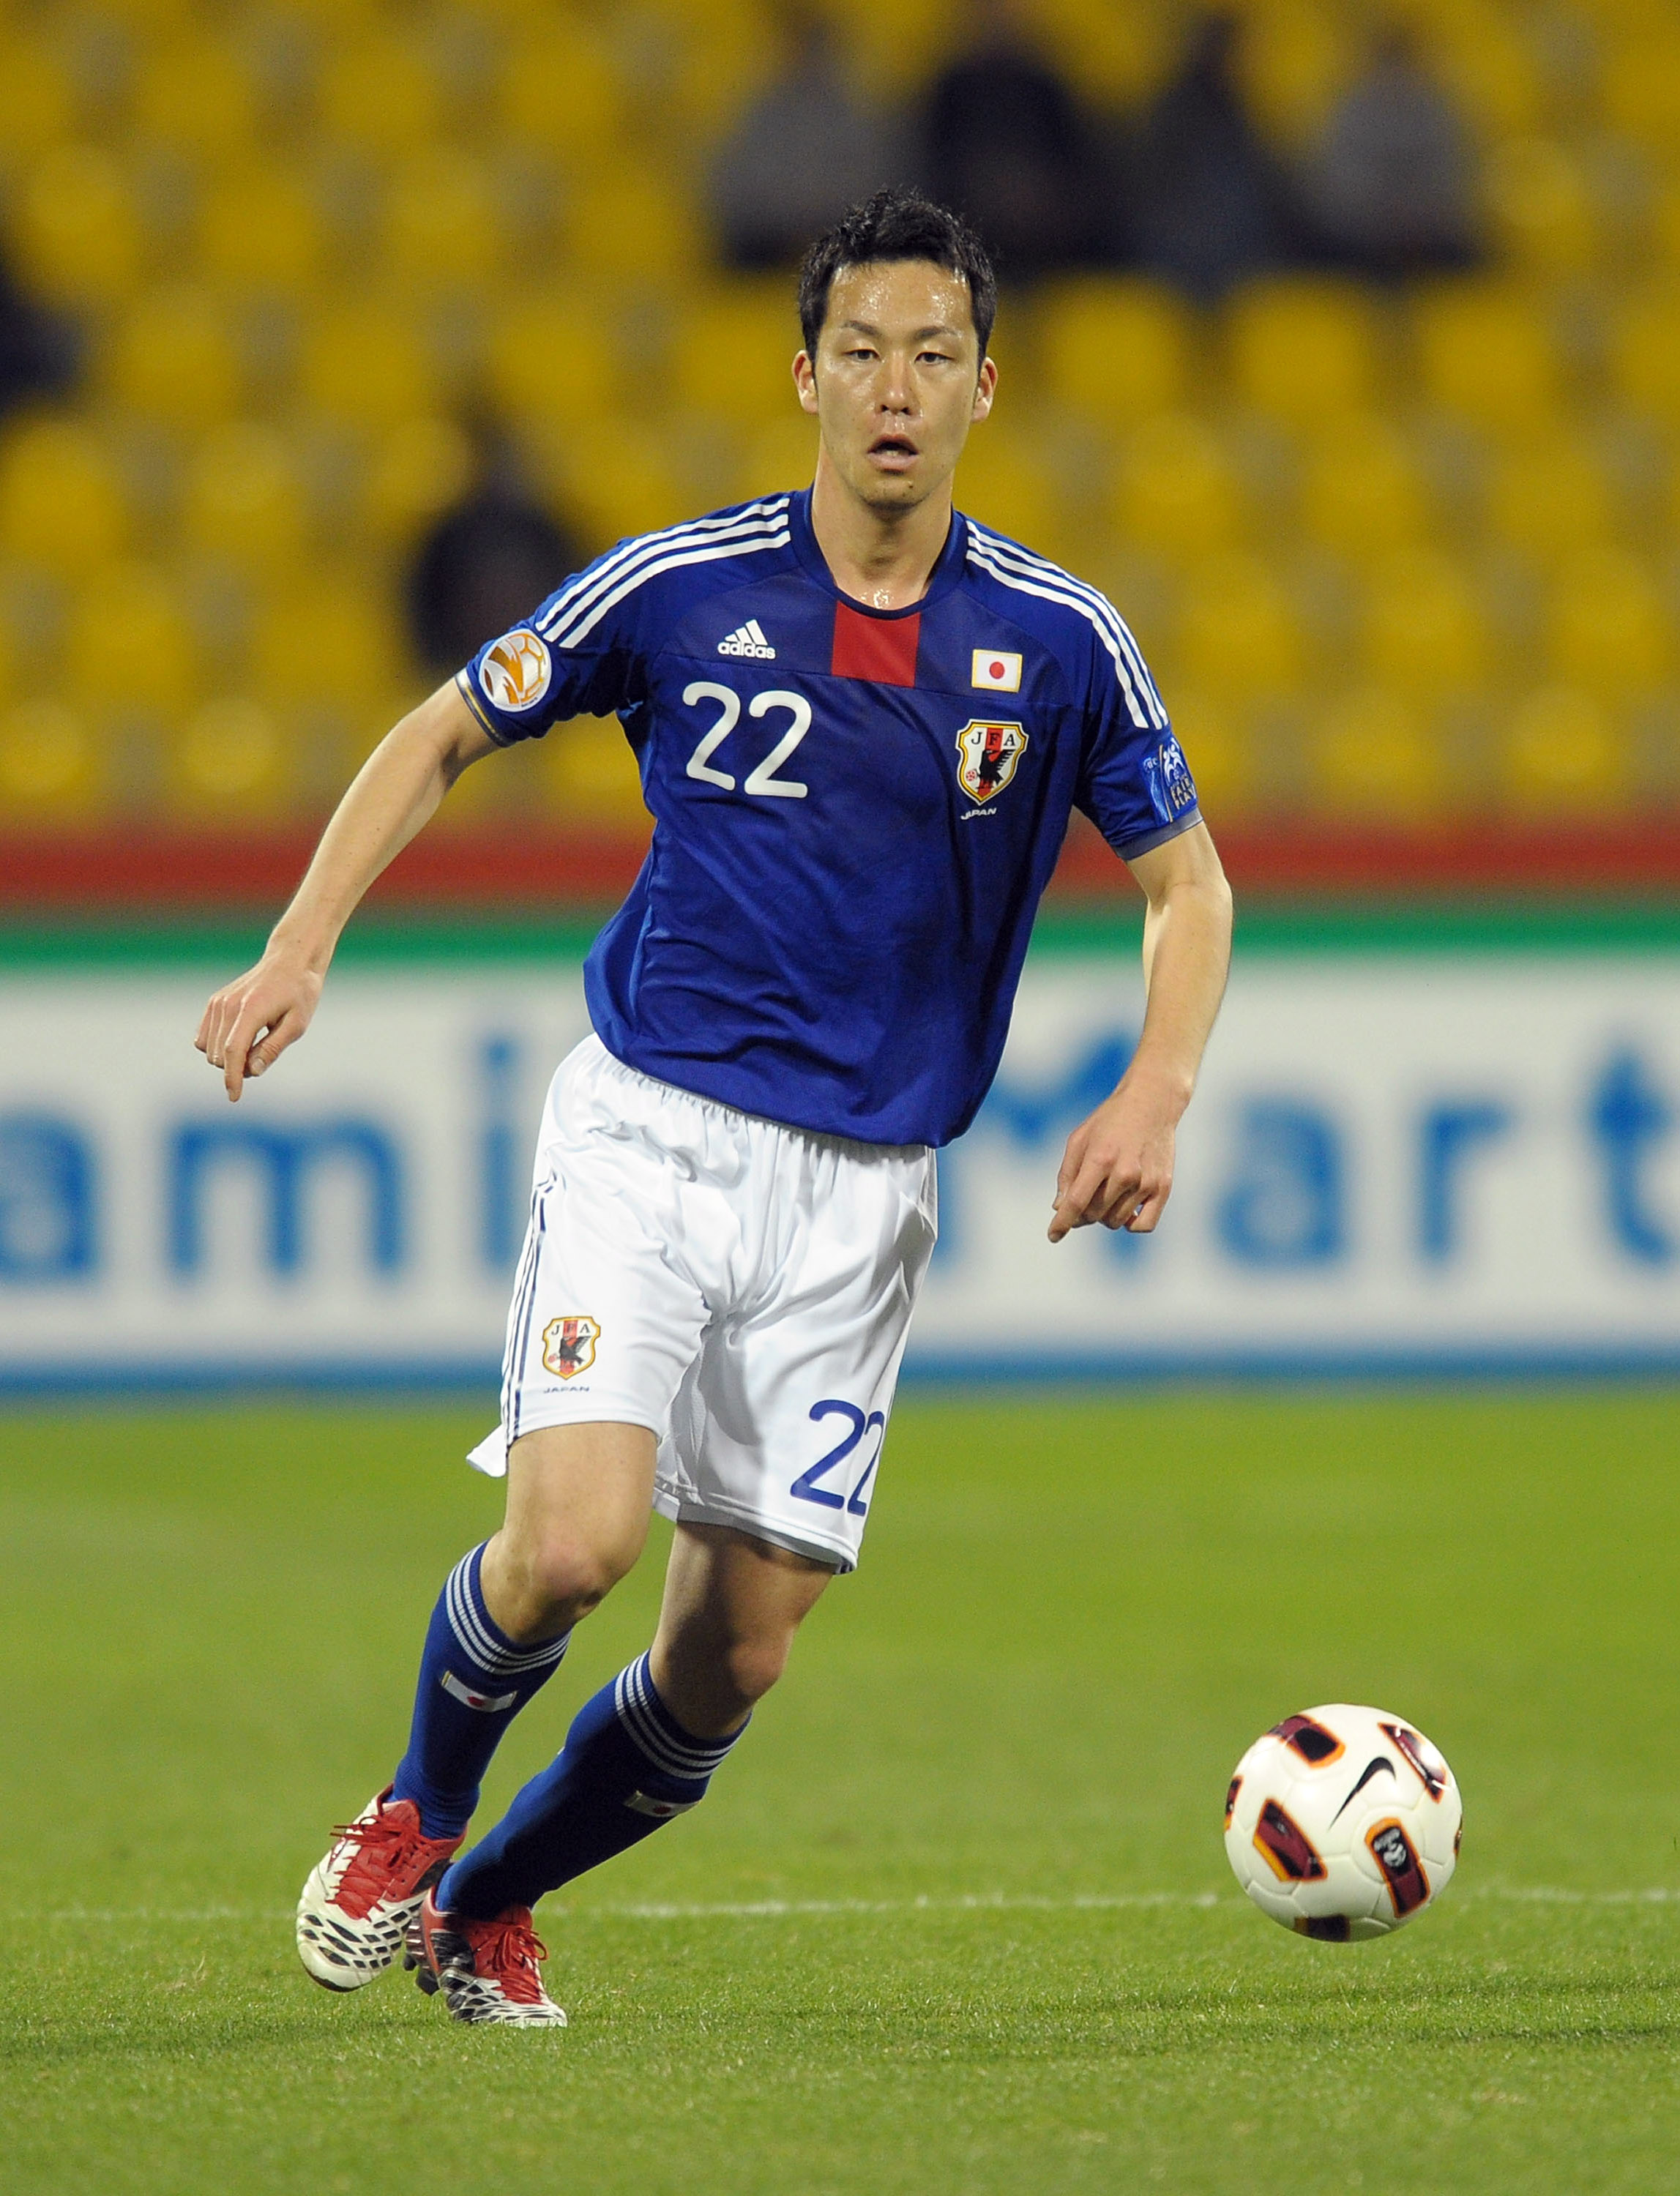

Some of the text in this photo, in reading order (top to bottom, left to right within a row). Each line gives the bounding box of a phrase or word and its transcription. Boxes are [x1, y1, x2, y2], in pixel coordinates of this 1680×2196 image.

[717, 640, 776, 660] adidas
[682, 681, 813, 799] 22
[971, 731, 1017, 747] JFA
[961, 807, 996, 821] JAPAN
[551, 1323, 591, 1335] JFA
[790, 1399, 885, 1517] 22
